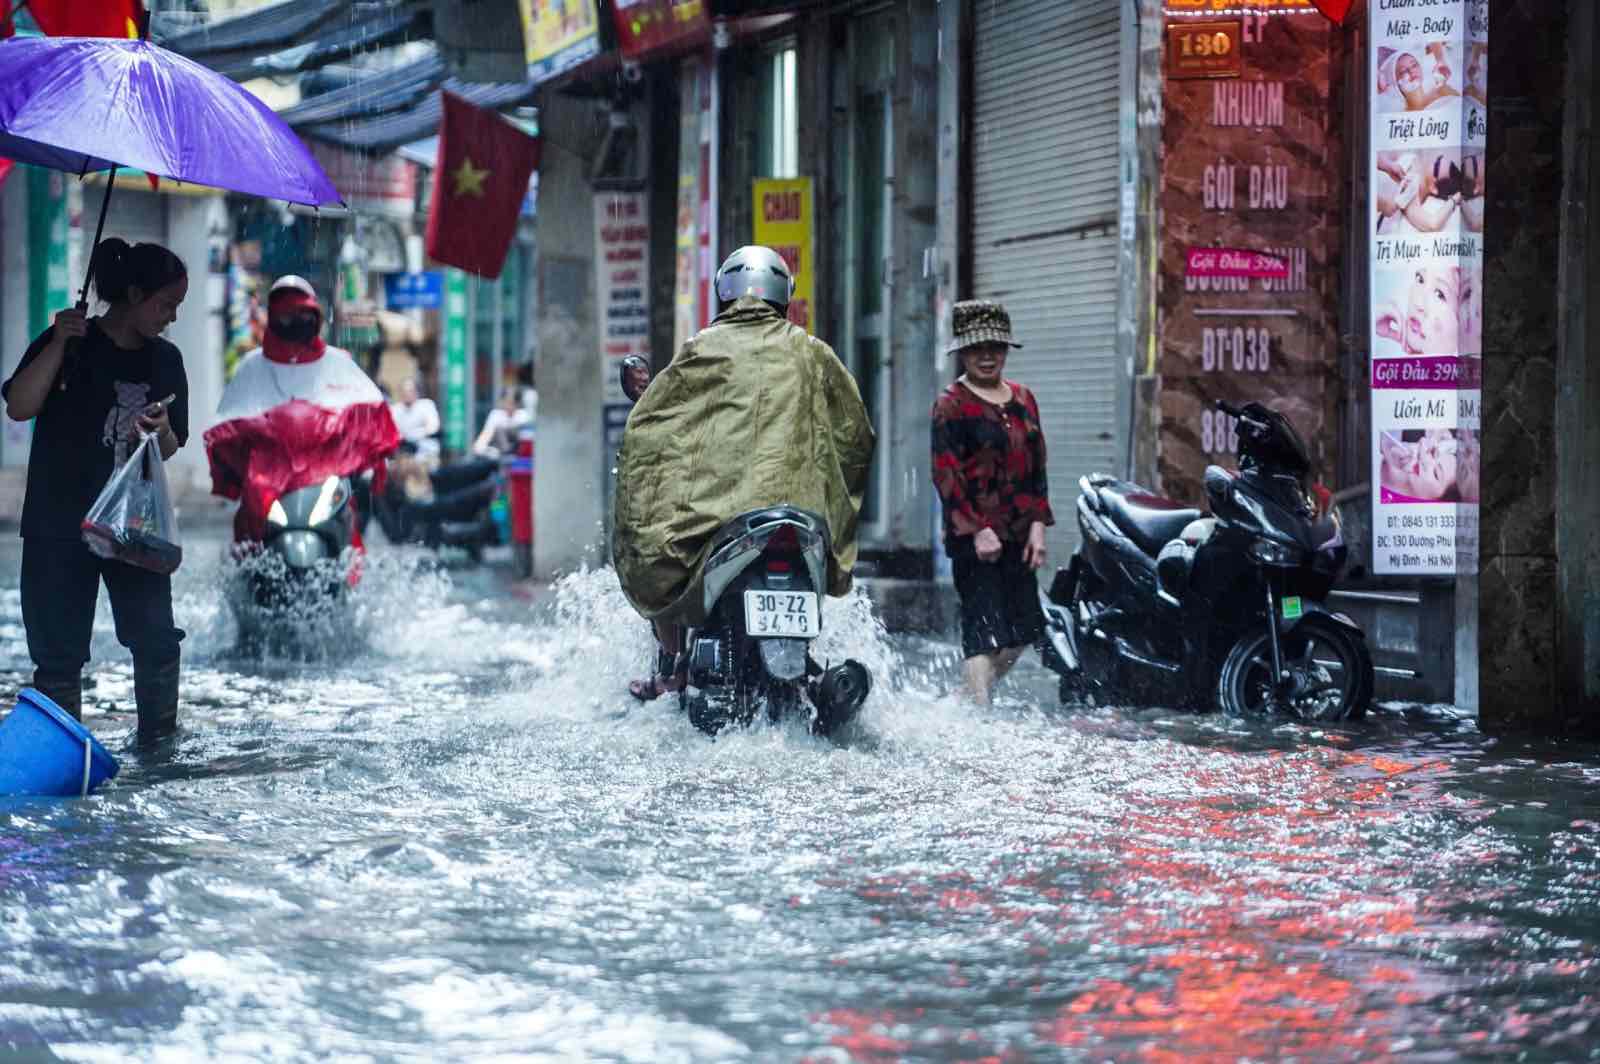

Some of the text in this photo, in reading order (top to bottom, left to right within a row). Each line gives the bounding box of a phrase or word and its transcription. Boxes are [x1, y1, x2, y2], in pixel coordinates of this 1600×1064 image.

[1386, 19, 1411, 39] Mặt
[1422, 17, 1453, 36] Body
[1178, 32, 1231, 56] 130
[1213, 73, 1285, 133] NHUỘM
[1387, 118, 1415, 142] Triệt
[1419, 116, 1449, 141] Lông
[1376, 241, 1391, 264] Trị
[1393, 239, 1422, 263] Mụn
[1376, 362, 1400, 384] Gội
[1393, 396, 1423, 419] Uốn
[1402, 515, 1424, 528] 0845
[1425, 515, 1439, 528] 131
[1440, 515, 1456, 528] 333
[1393, 535, 1407, 547] 130
